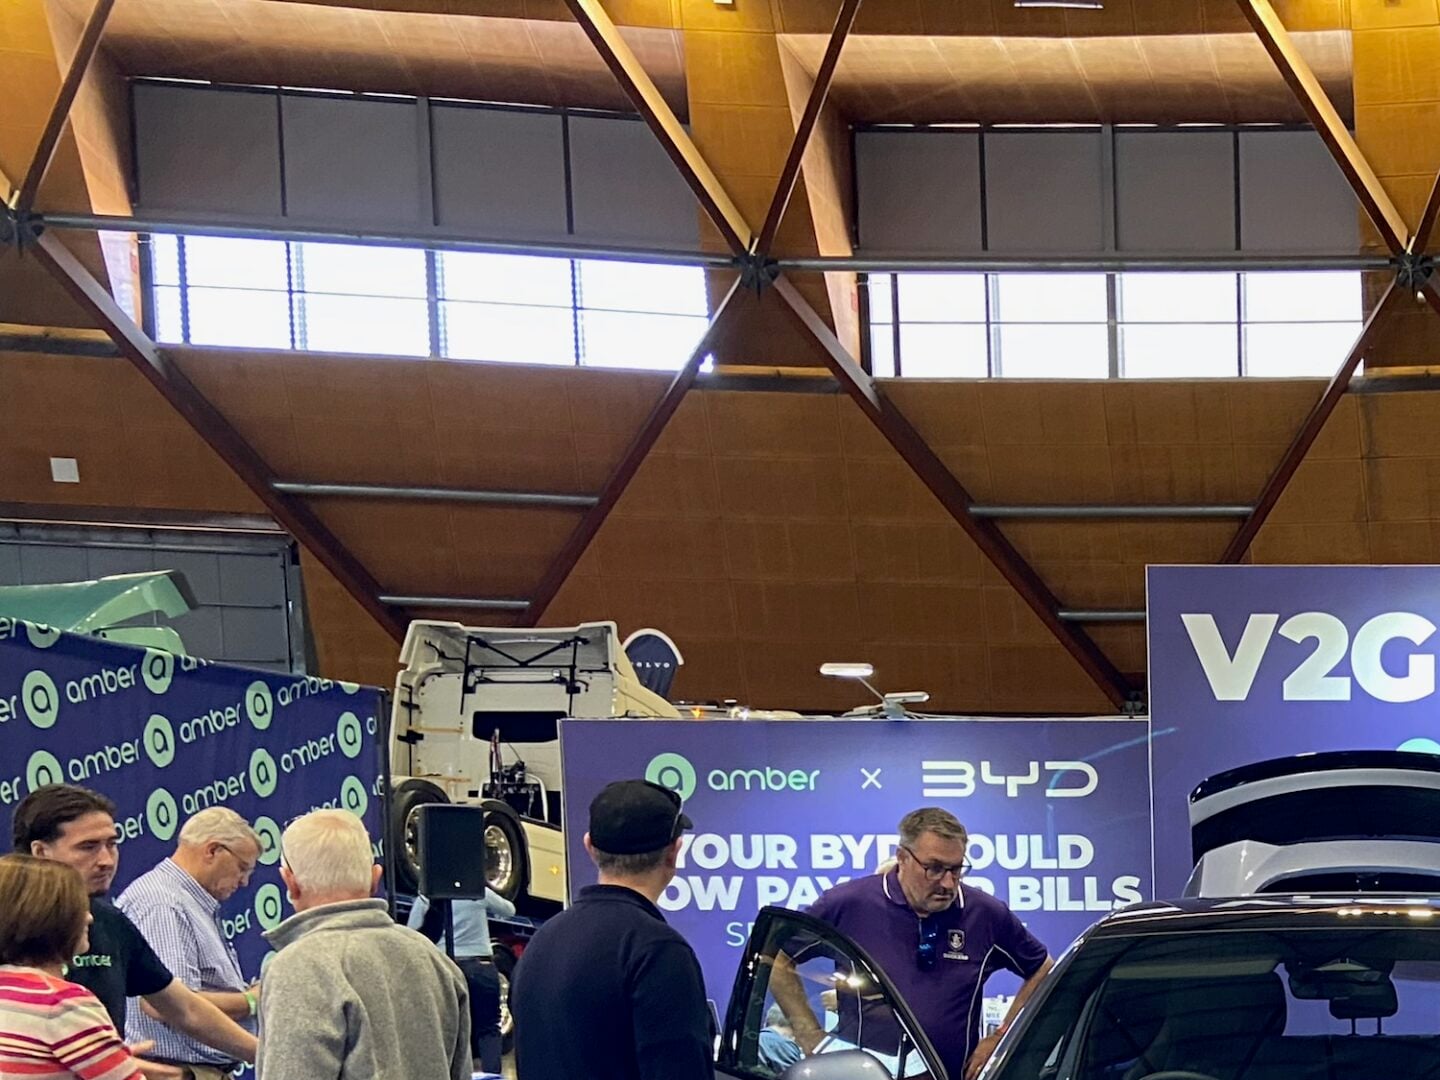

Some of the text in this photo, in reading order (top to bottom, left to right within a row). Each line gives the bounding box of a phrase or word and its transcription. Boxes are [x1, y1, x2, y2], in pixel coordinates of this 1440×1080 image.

[1180, 611, 1438, 703] V2G
[66, 664, 138, 704] amber
[68, 738, 140, 781] amber
[180, 703, 241, 743] amber
[182, 772, 246, 815] amber
[281, 733, 335, 773] amber
[708, 766, 820, 791] amber
[922, 761, 1098, 797] BYD
[675, 833, 798, 870] YOUR
[963, 834, 1094, 870] OULD
[657, 876, 743, 911] OW
[1008, 876, 1143, 911] BILLS
